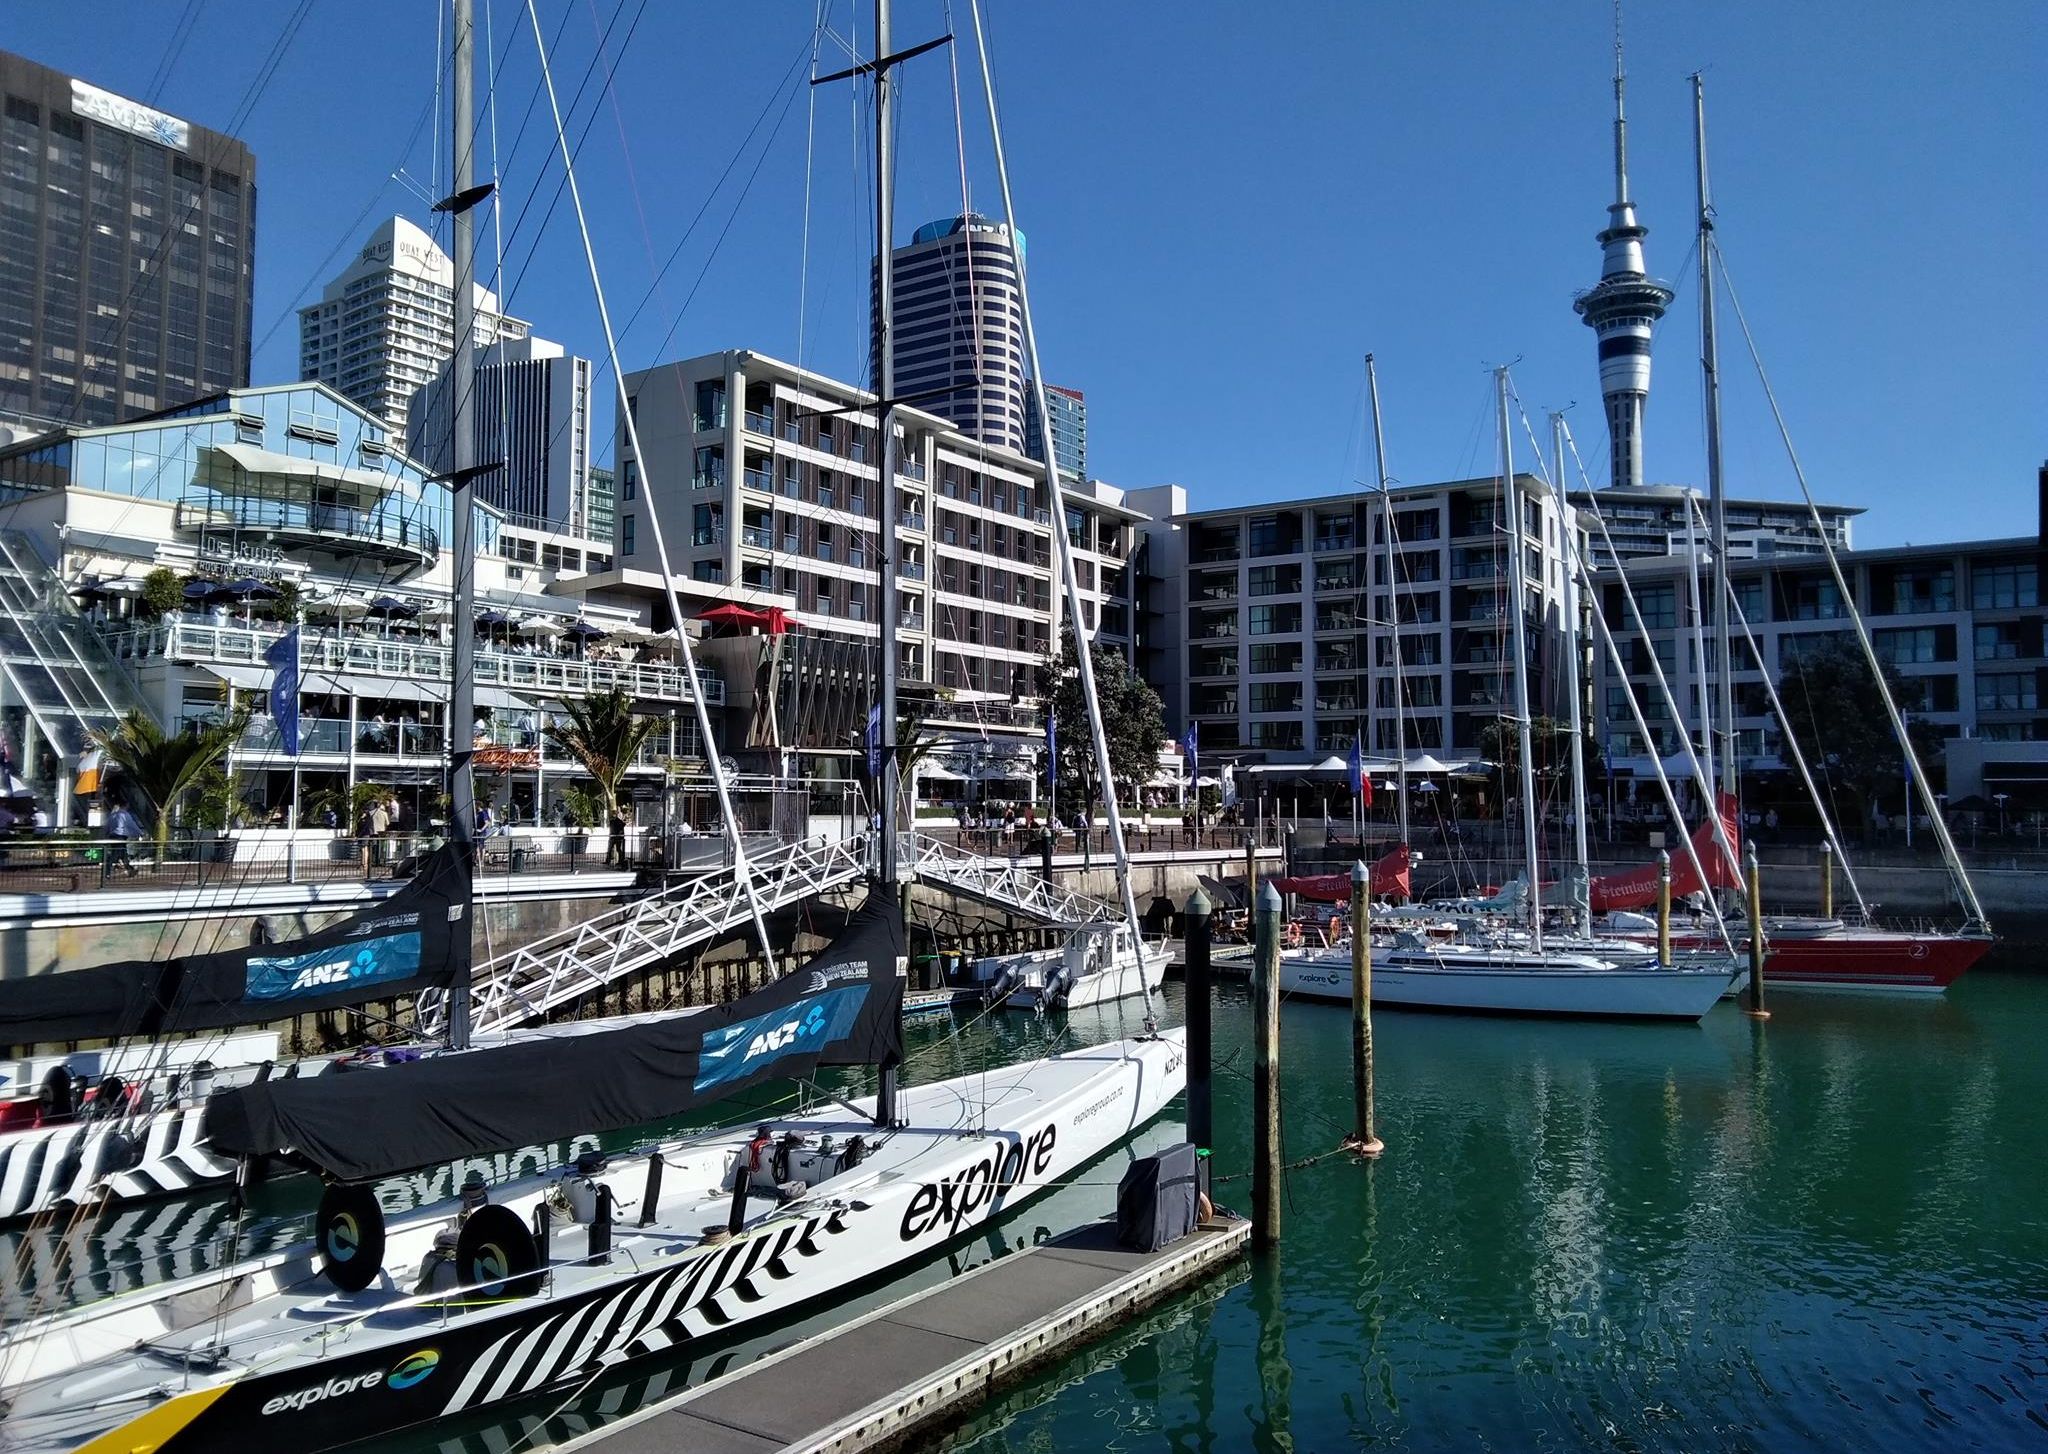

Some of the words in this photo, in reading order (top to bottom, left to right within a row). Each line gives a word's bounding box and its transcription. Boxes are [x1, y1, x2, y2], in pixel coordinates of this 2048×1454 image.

[399, 241, 420, 257] QUAY
[424, 249, 445, 265] WEST
[1599, 880, 1658, 898] Steinlage
[291, 960, 350, 991] ANZ
[826, 972, 840, 981] NEW
[840, 968, 868, 977] ZEALAND
[849, 961, 868, 969] TEAM
[742, 1020, 800, 1063] ANZ
[900, 1123, 1056, 1242] explore
[261, 1371, 383, 1416] explore
